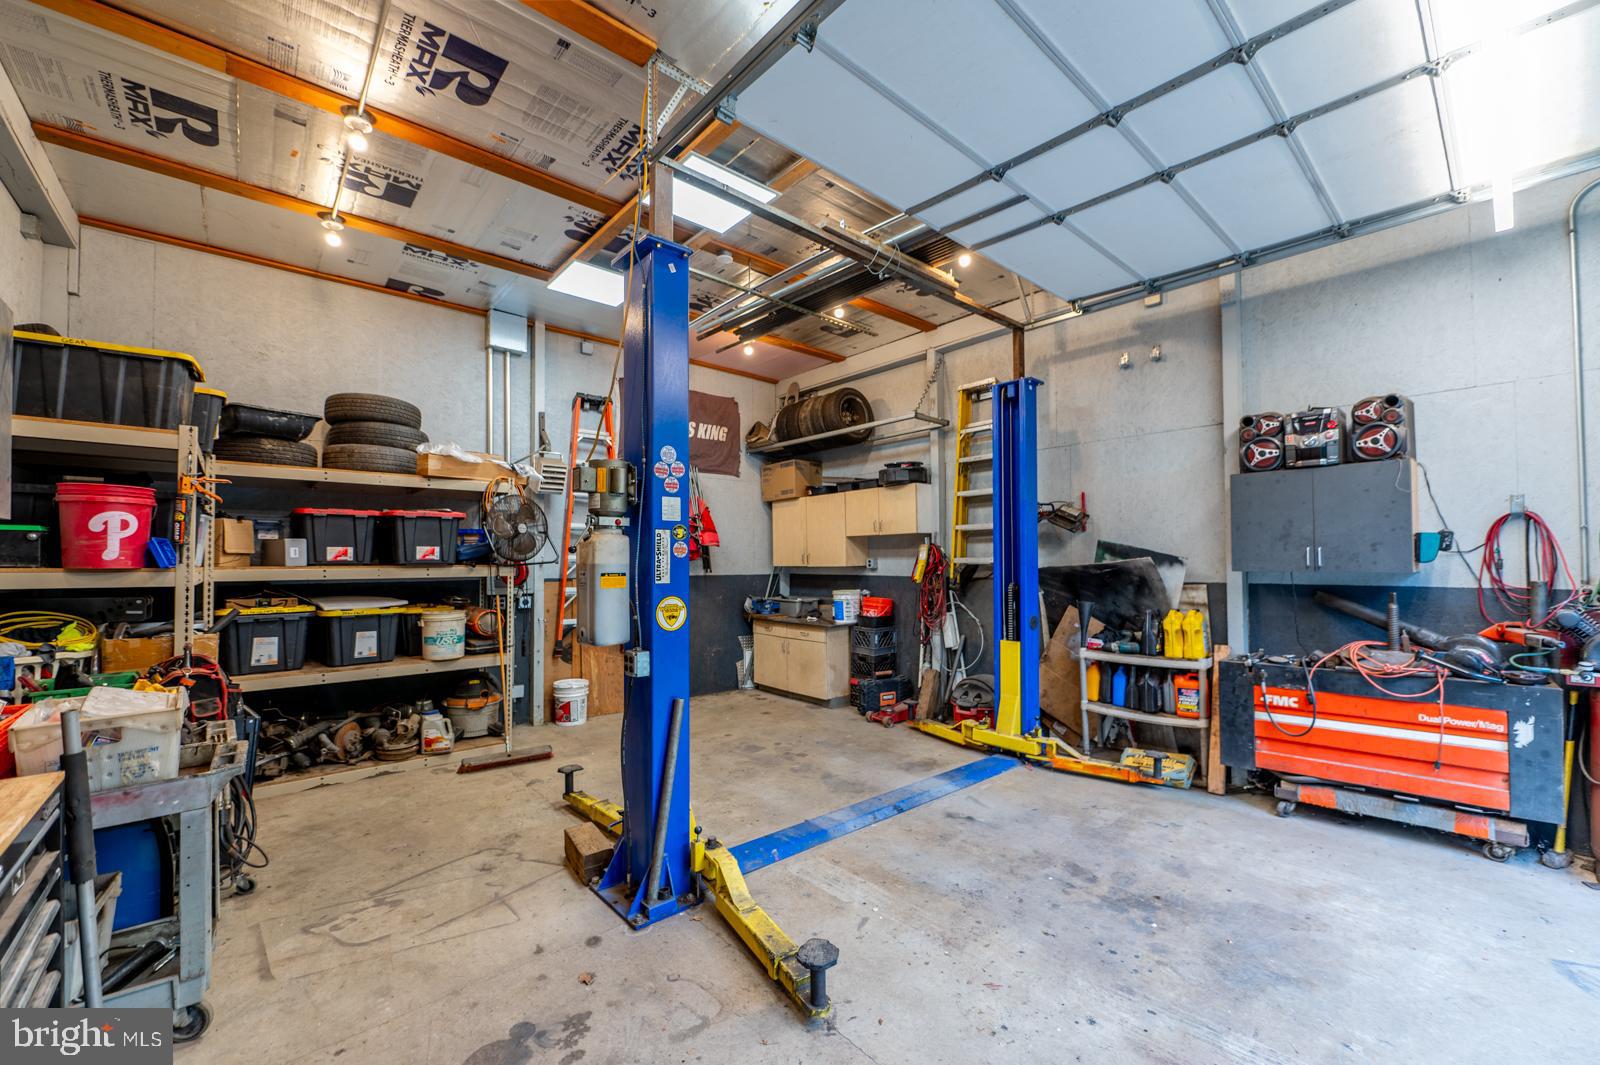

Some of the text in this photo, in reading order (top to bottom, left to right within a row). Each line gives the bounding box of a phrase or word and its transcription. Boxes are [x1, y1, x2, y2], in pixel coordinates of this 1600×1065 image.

[405, 21, 447, 85] MAX
[120, 77, 154, 130] MAX
[696, 423, 729, 442] KING
[88, 510, 139, 561] P
[1260, 694, 1299, 708] FMC
